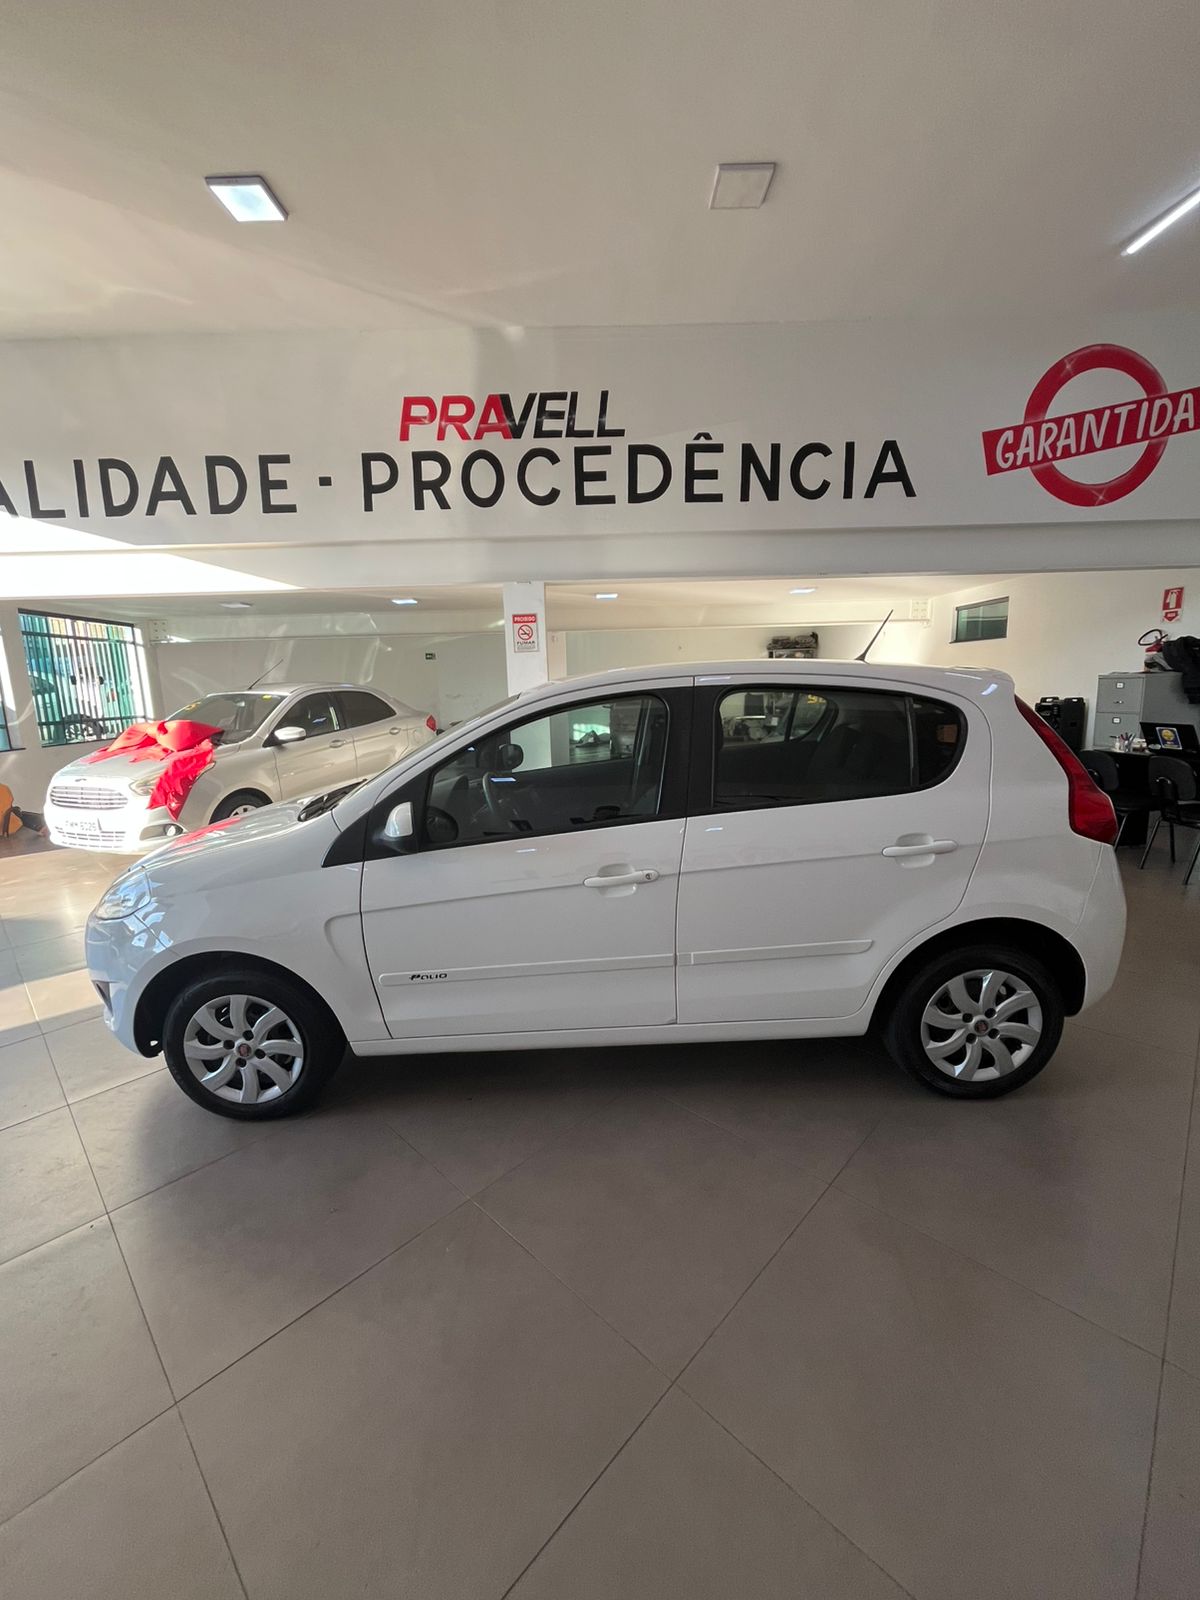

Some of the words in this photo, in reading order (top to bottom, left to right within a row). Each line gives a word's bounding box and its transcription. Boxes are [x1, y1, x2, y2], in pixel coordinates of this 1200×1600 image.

[400, 390, 625, 441] PRAVELL
[995, 392, 1195, 469] GARANTIDA
[361, 431, 917, 513] PROCEDÊNCIA
